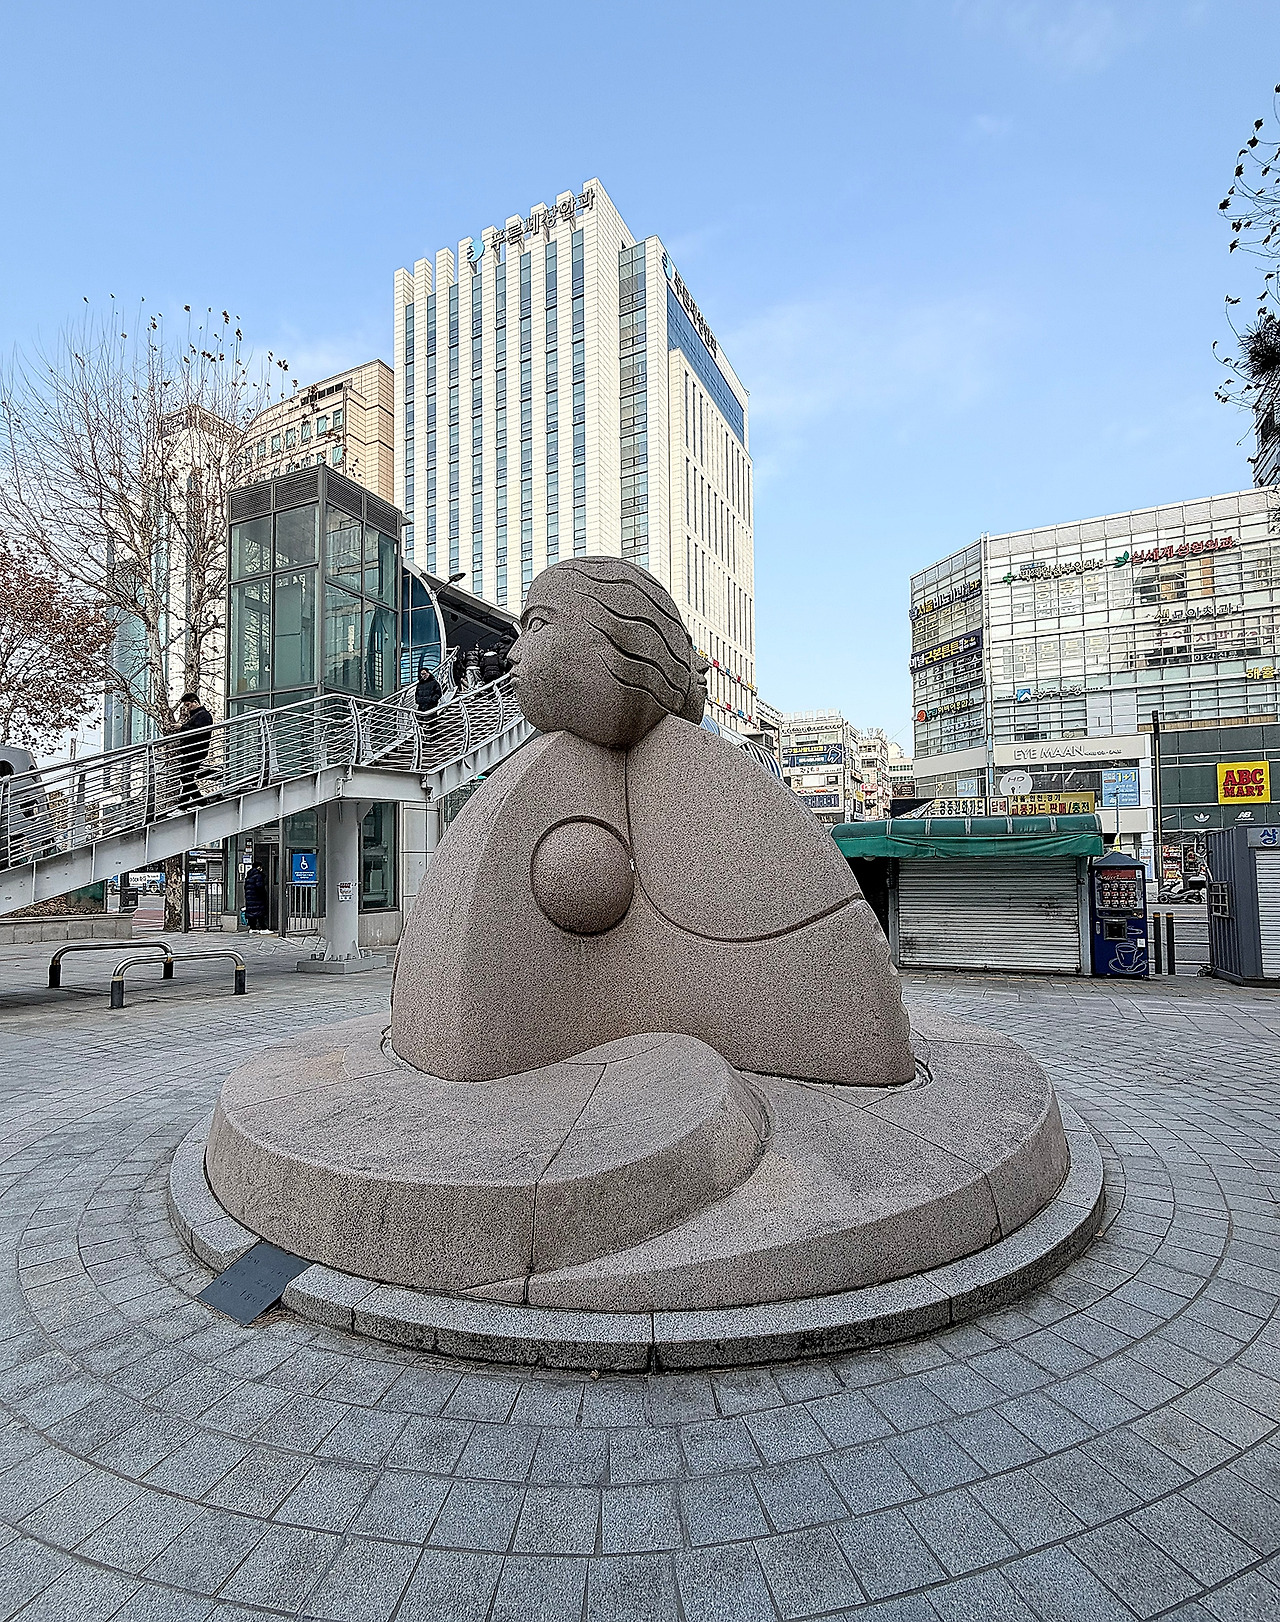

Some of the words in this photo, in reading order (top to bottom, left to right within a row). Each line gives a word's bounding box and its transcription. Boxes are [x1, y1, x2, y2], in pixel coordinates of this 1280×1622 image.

[490, 188, 595, 250] 푸른세상안과
[1131, 545, 1174, 563] 신세계
[1014, 748, 1037, 760] EYE
[1040, 745, 1084, 758] MAAN
[1223, 768, 1264, 786] ABC
[1223, 785, 1264, 797] MART
[1011, 803, 1046, 816] 교통카드
[1049, 801, 1090, 814] 판매/충전
